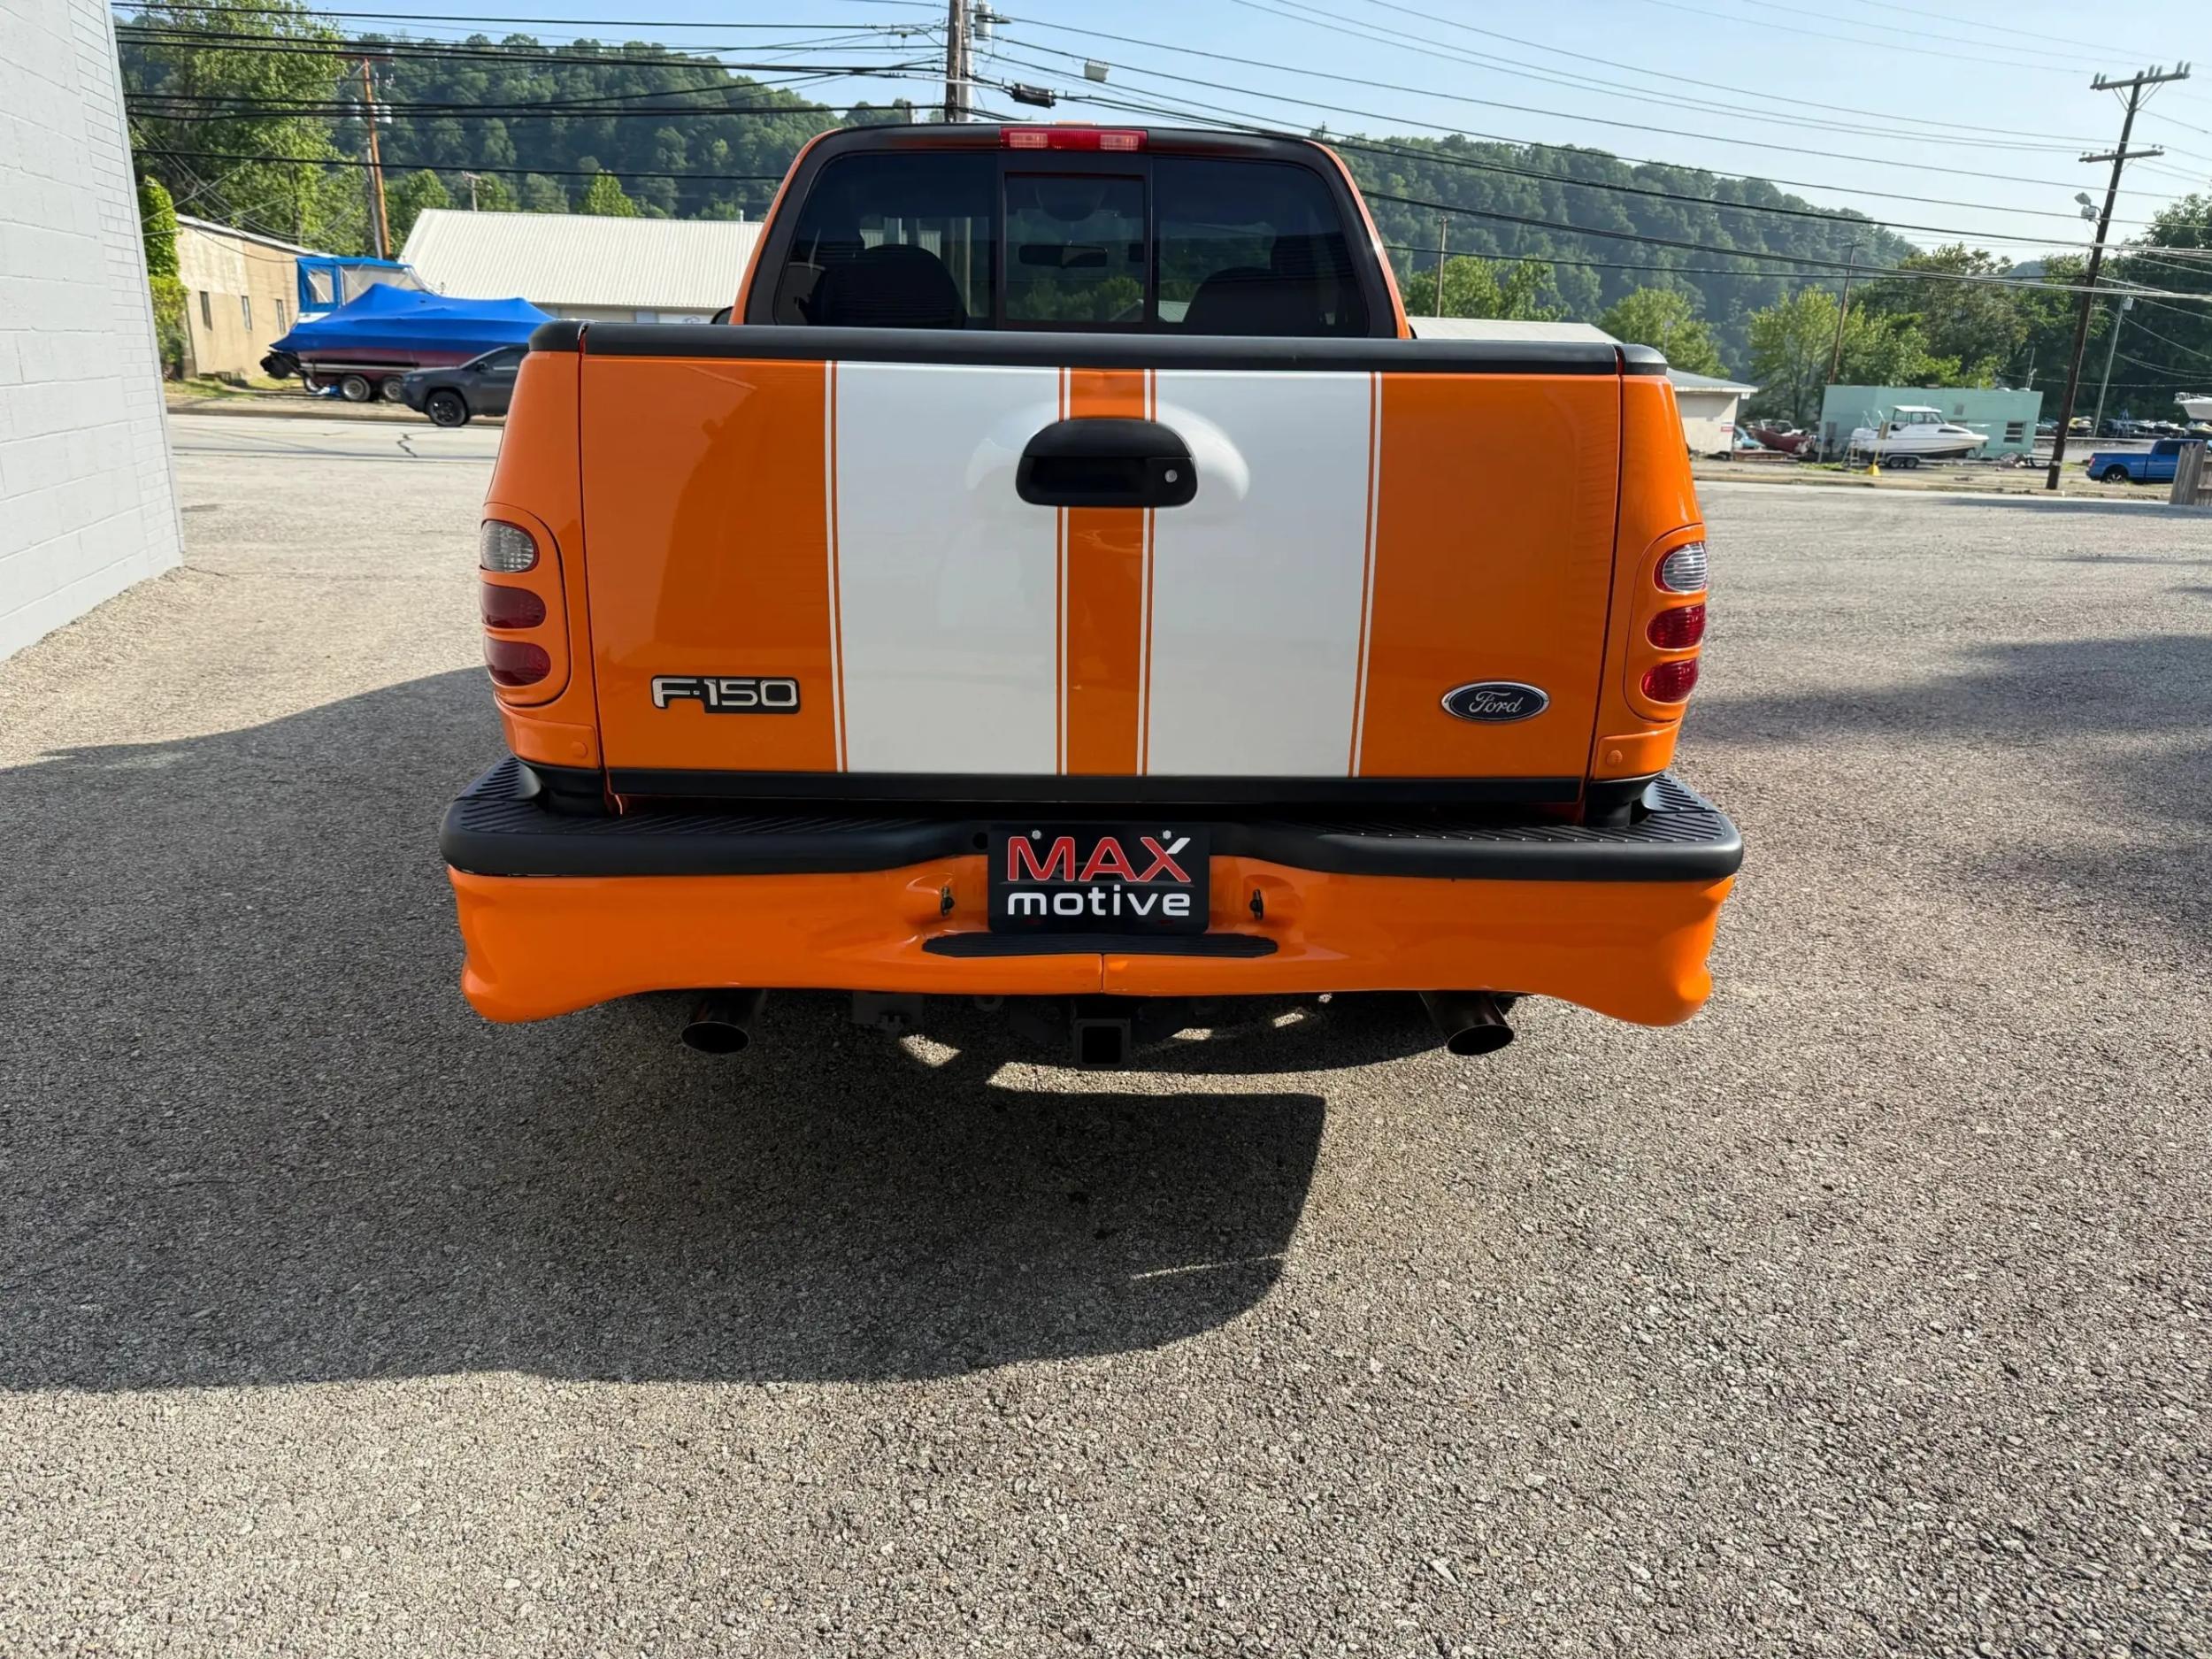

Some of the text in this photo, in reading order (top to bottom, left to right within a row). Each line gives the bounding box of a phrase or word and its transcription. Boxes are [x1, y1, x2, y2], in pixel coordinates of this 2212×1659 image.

[651, 677, 798, 708] F-150
[1469, 690, 1524, 712] Ford
[1008, 836, 1191, 882] MAX
[1008, 884, 1191, 916] motive
